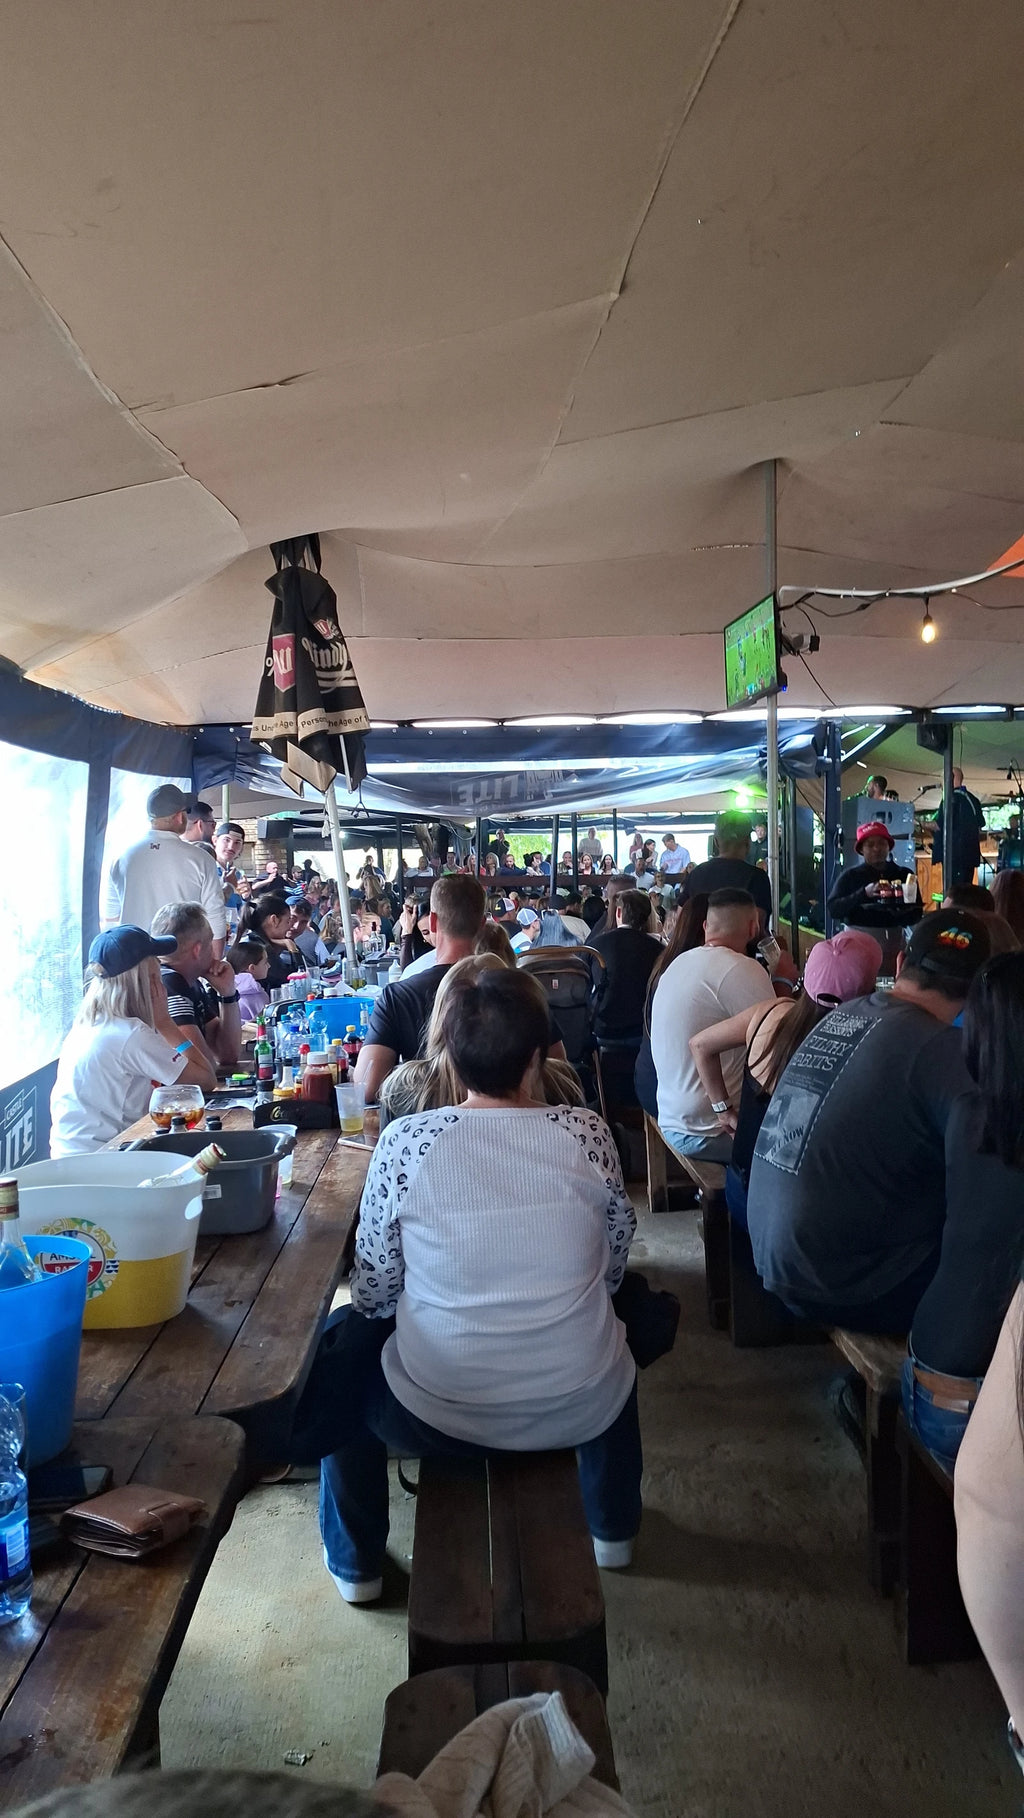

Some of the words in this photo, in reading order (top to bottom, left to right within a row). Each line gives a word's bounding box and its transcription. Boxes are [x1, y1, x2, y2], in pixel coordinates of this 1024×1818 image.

[279, 720, 294, 729] Age
[338, 718, 352, 727] Age
[804, 1035, 853, 1057] FILTHY
[789, 1052, 838, 1071] ABITS
